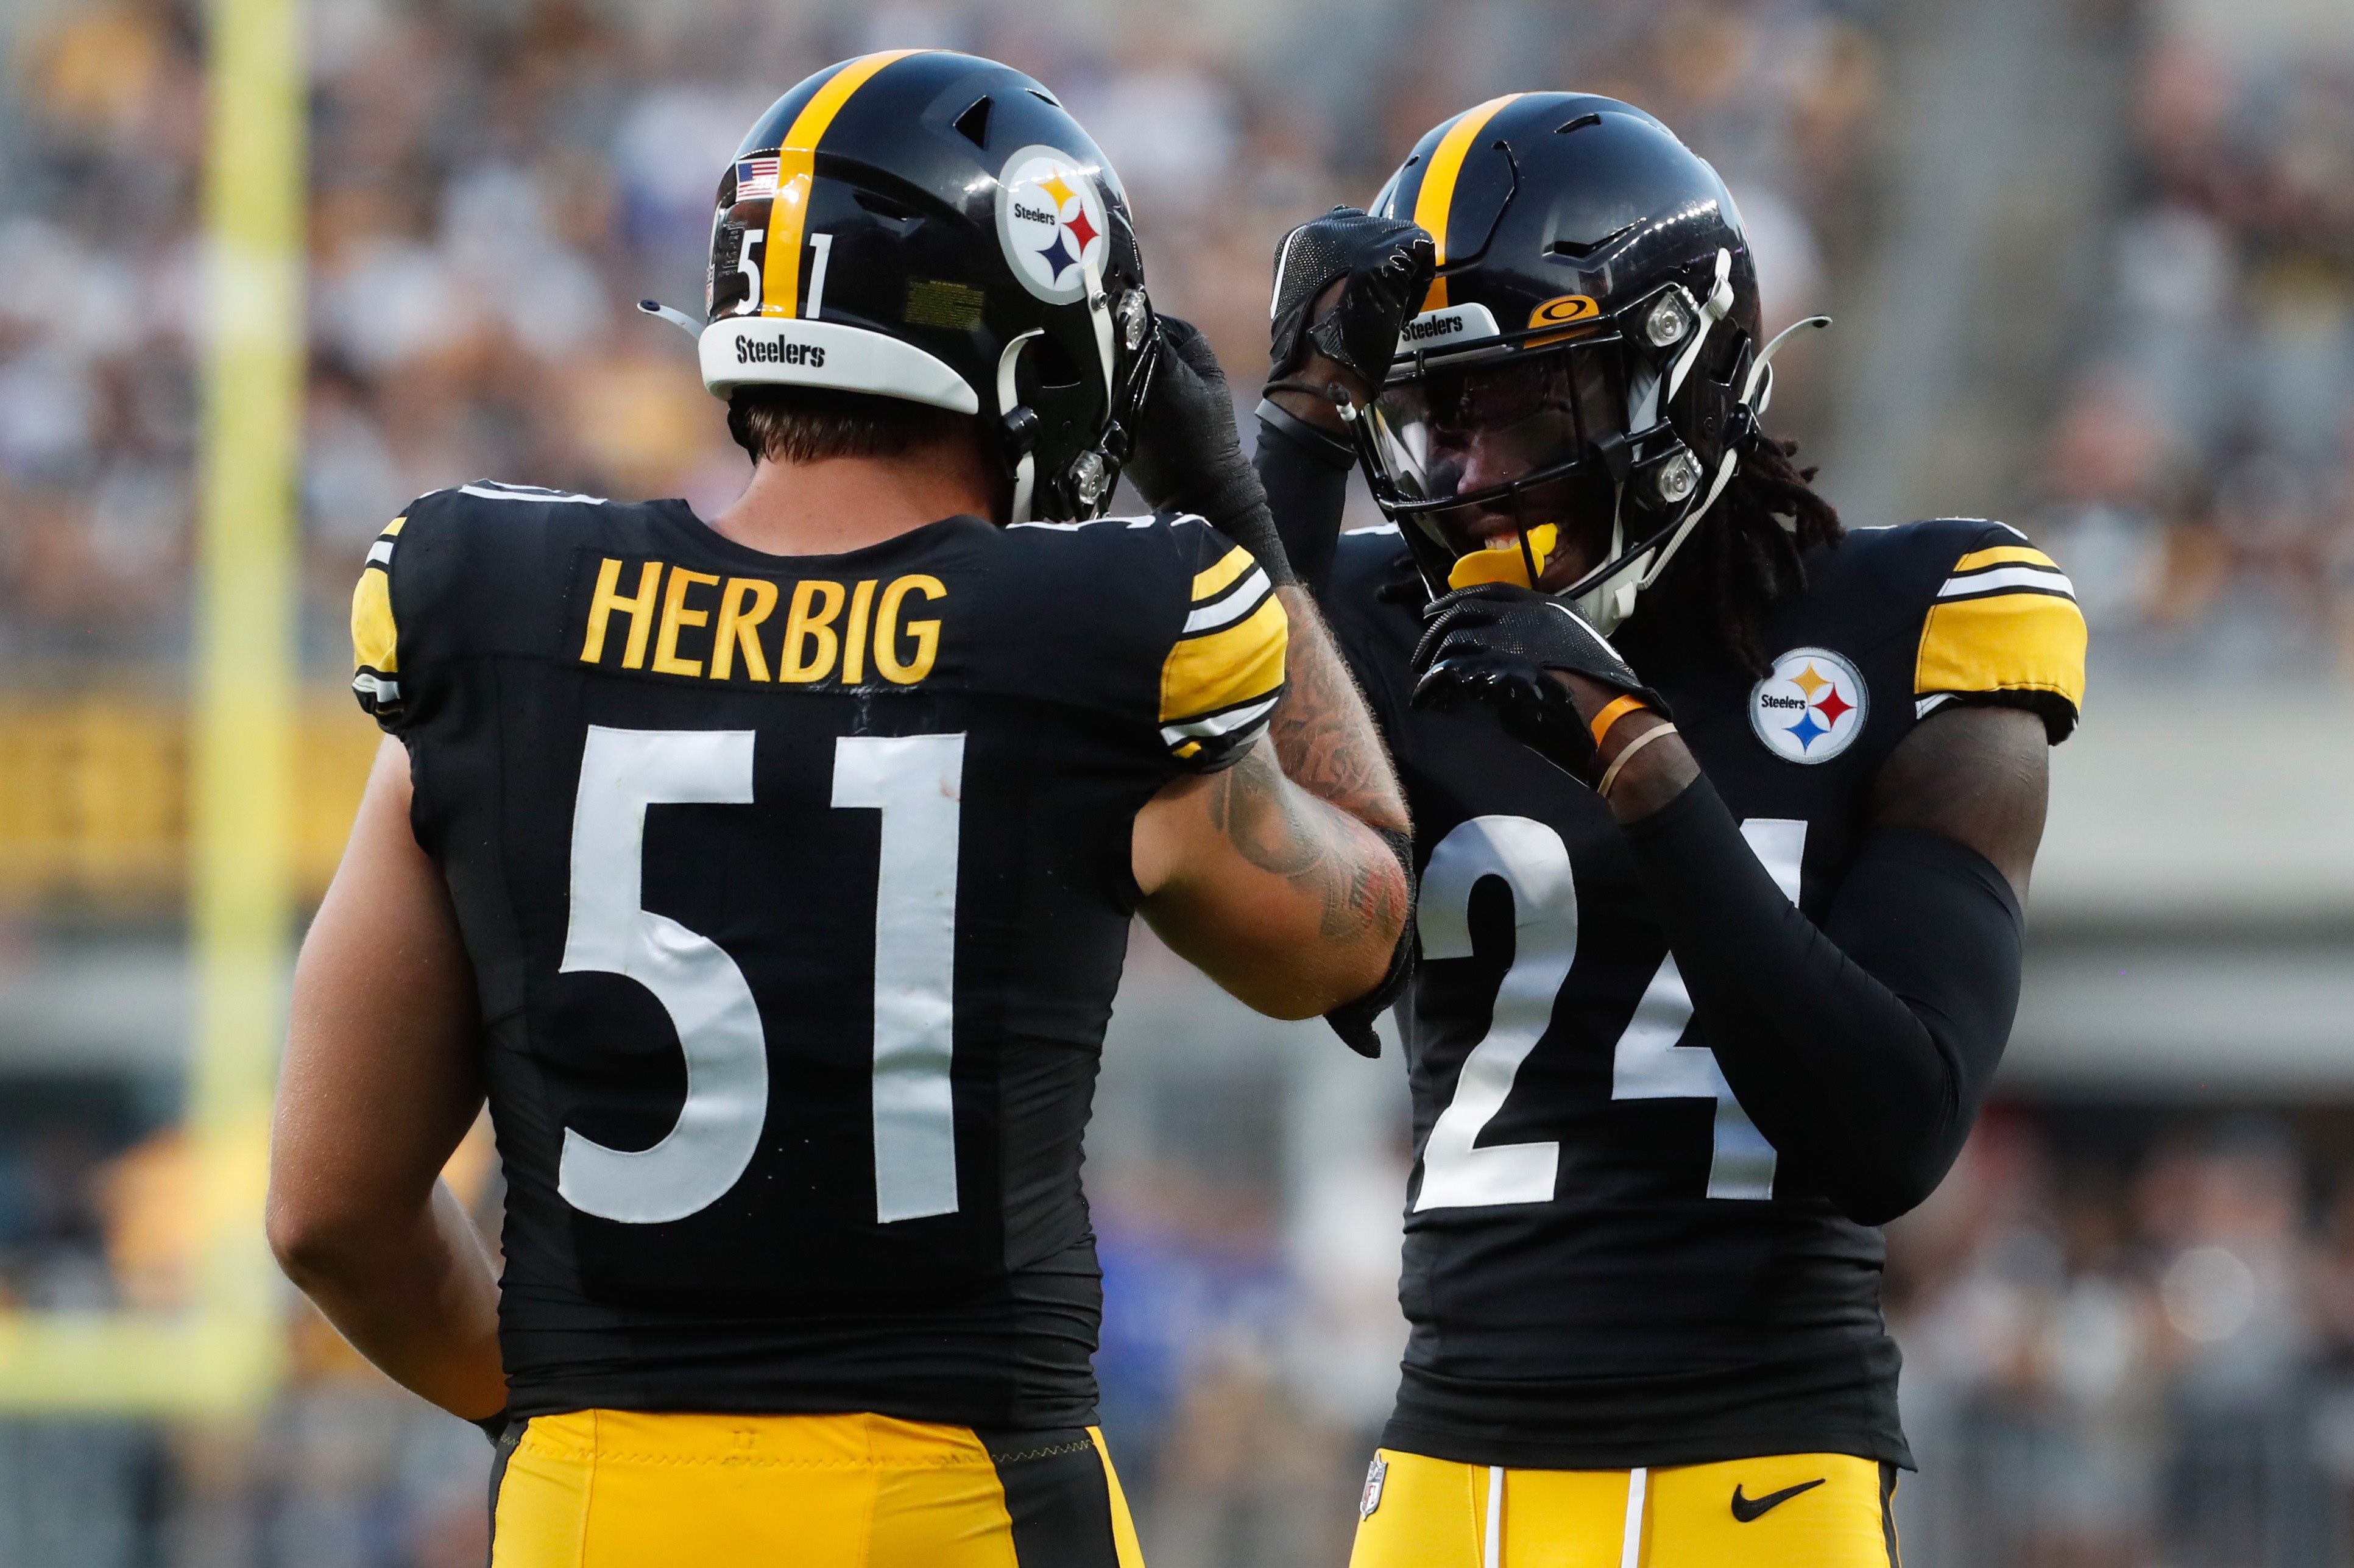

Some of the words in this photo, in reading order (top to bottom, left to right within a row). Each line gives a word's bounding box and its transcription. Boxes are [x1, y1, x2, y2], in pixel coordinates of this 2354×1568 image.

[1014, 203, 1055, 225] Steelers
[1401, 315, 1463, 342] Steelers
[735, 334, 825, 368] Steelers
[579, 558, 947, 685] HERBIG
[1761, 694, 1806, 709] Steelers
[557, 724, 967, 1224] 51
